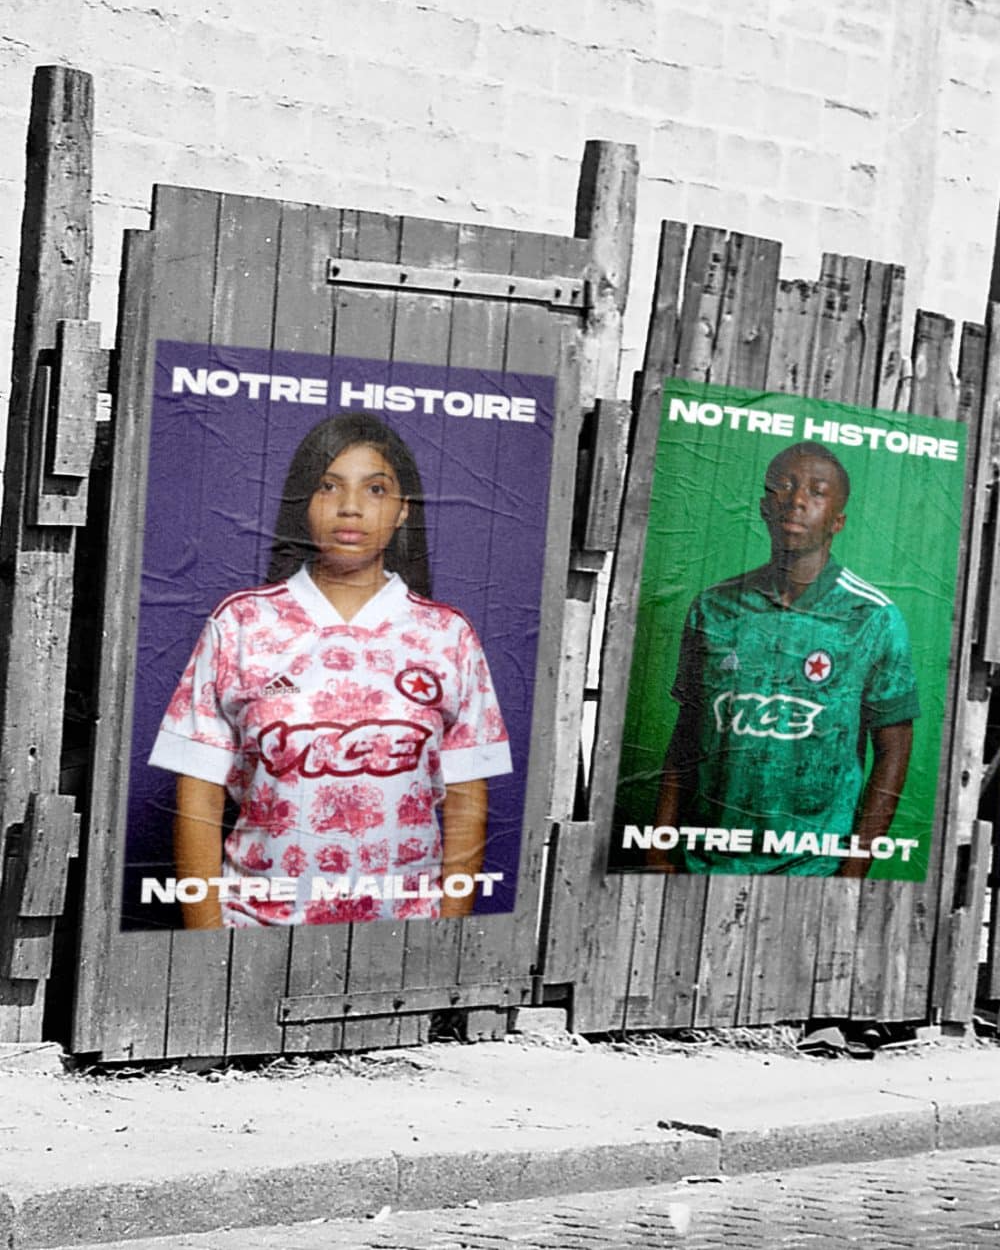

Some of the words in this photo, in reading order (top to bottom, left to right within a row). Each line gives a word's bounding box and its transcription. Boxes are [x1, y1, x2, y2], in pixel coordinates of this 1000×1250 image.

[171, 366, 328, 405] NOTRE
[339, 381, 537, 423] HISTOIRE
[668, 398, 794, 437] NOTRE
[803, 418, 959, 462] HISTOIRE
[257, 719, 432, 779] VICE
[622, 825, 753, 854] NOTRE
[762, 830, 919, 863] MAILLOT
[140, 877, 298, 904] NOTRE
[310, 872, 504, 901] MAILLOT
